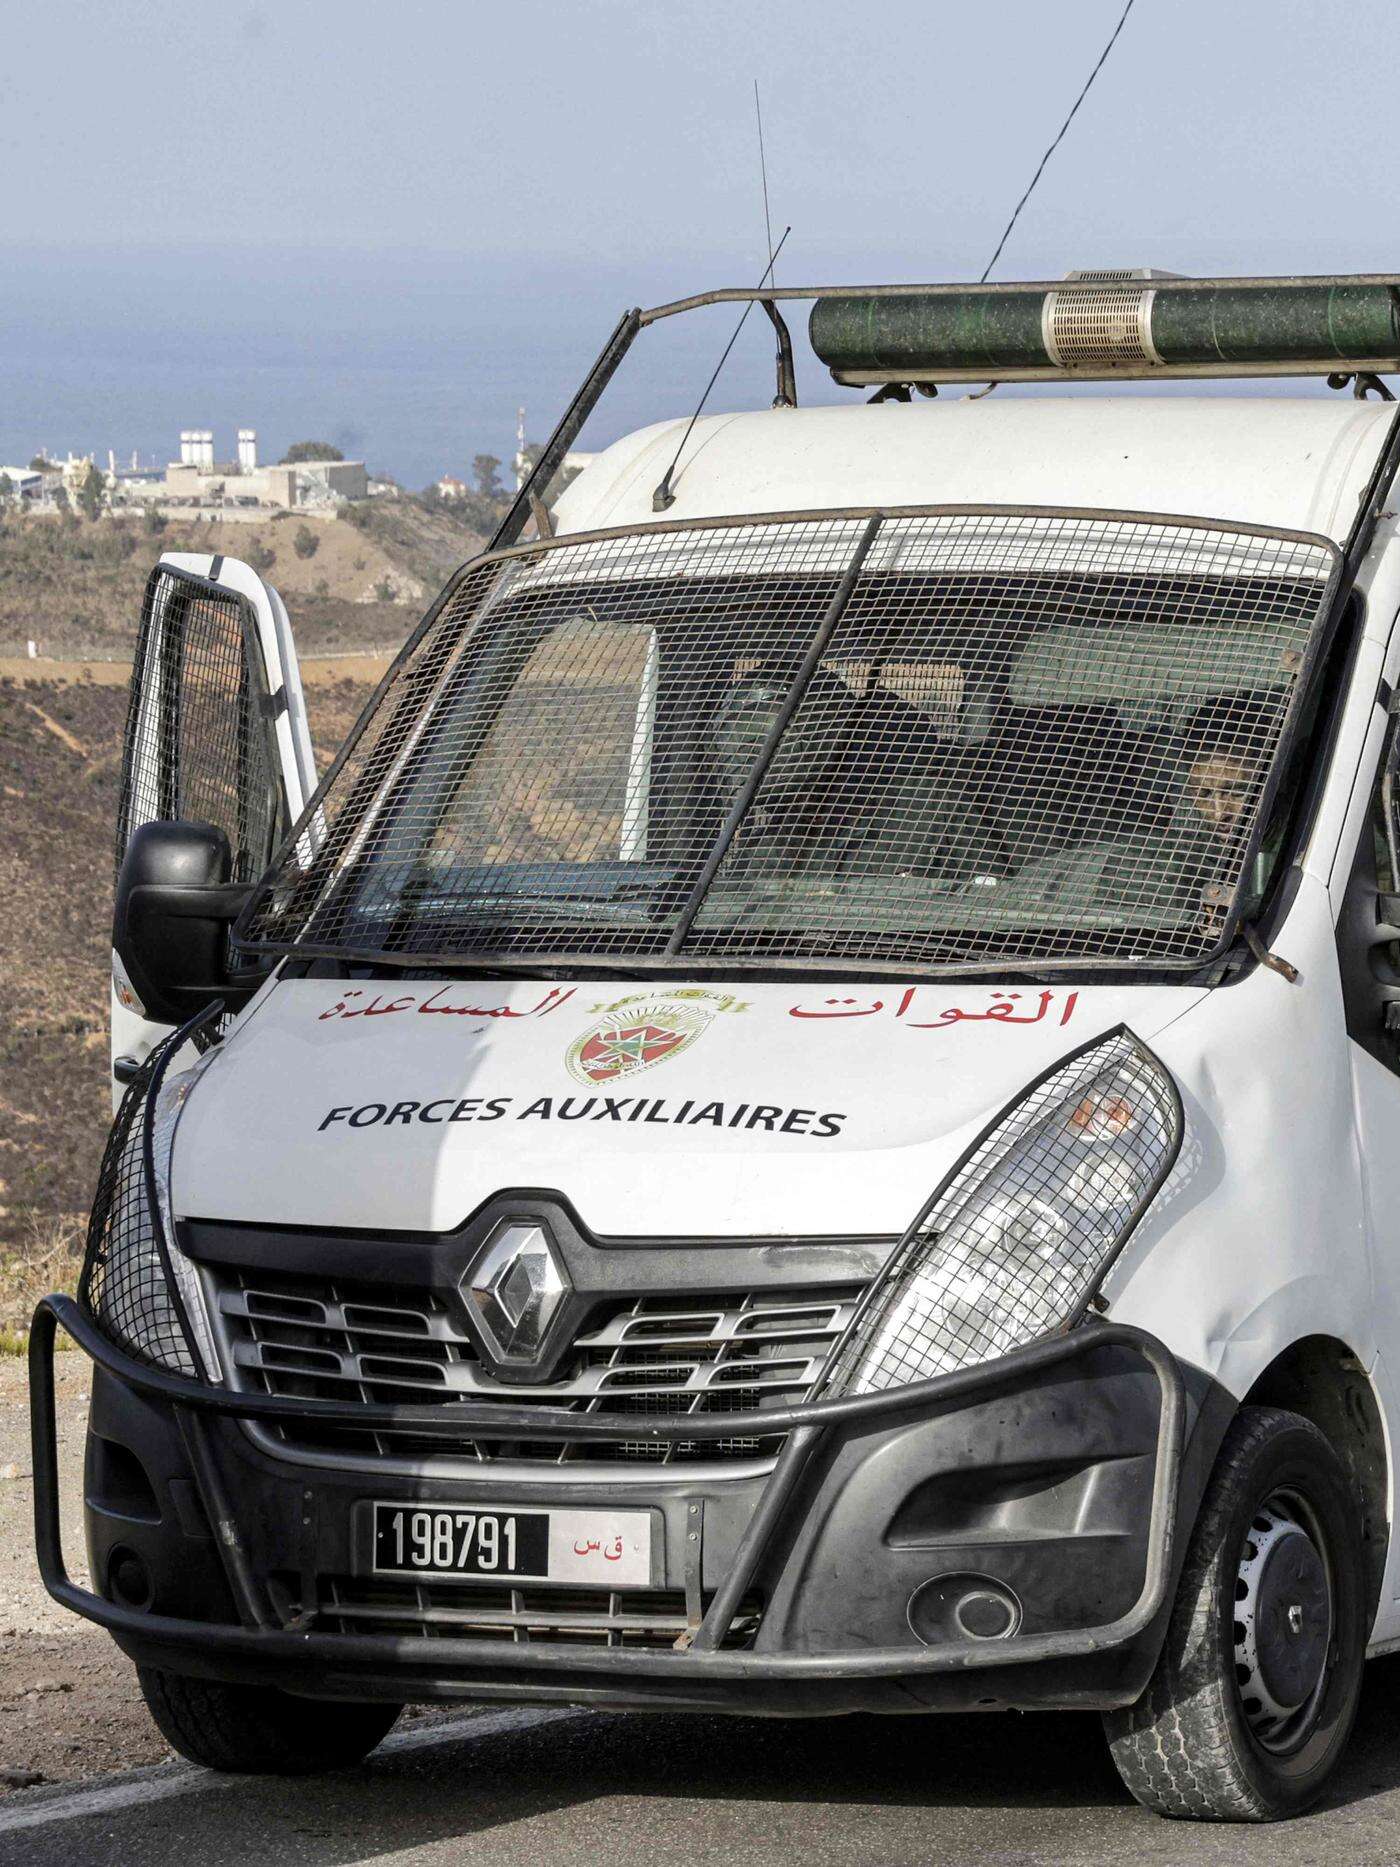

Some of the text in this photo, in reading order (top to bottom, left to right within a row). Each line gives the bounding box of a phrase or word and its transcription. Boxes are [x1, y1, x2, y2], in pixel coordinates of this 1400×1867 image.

[318, 985, 1080, 1028] القوات المساعدة
[317, 1097, 847, 1137] FORCES AUXILIAIRES
[392, 1512, 518, 1571] 198791
